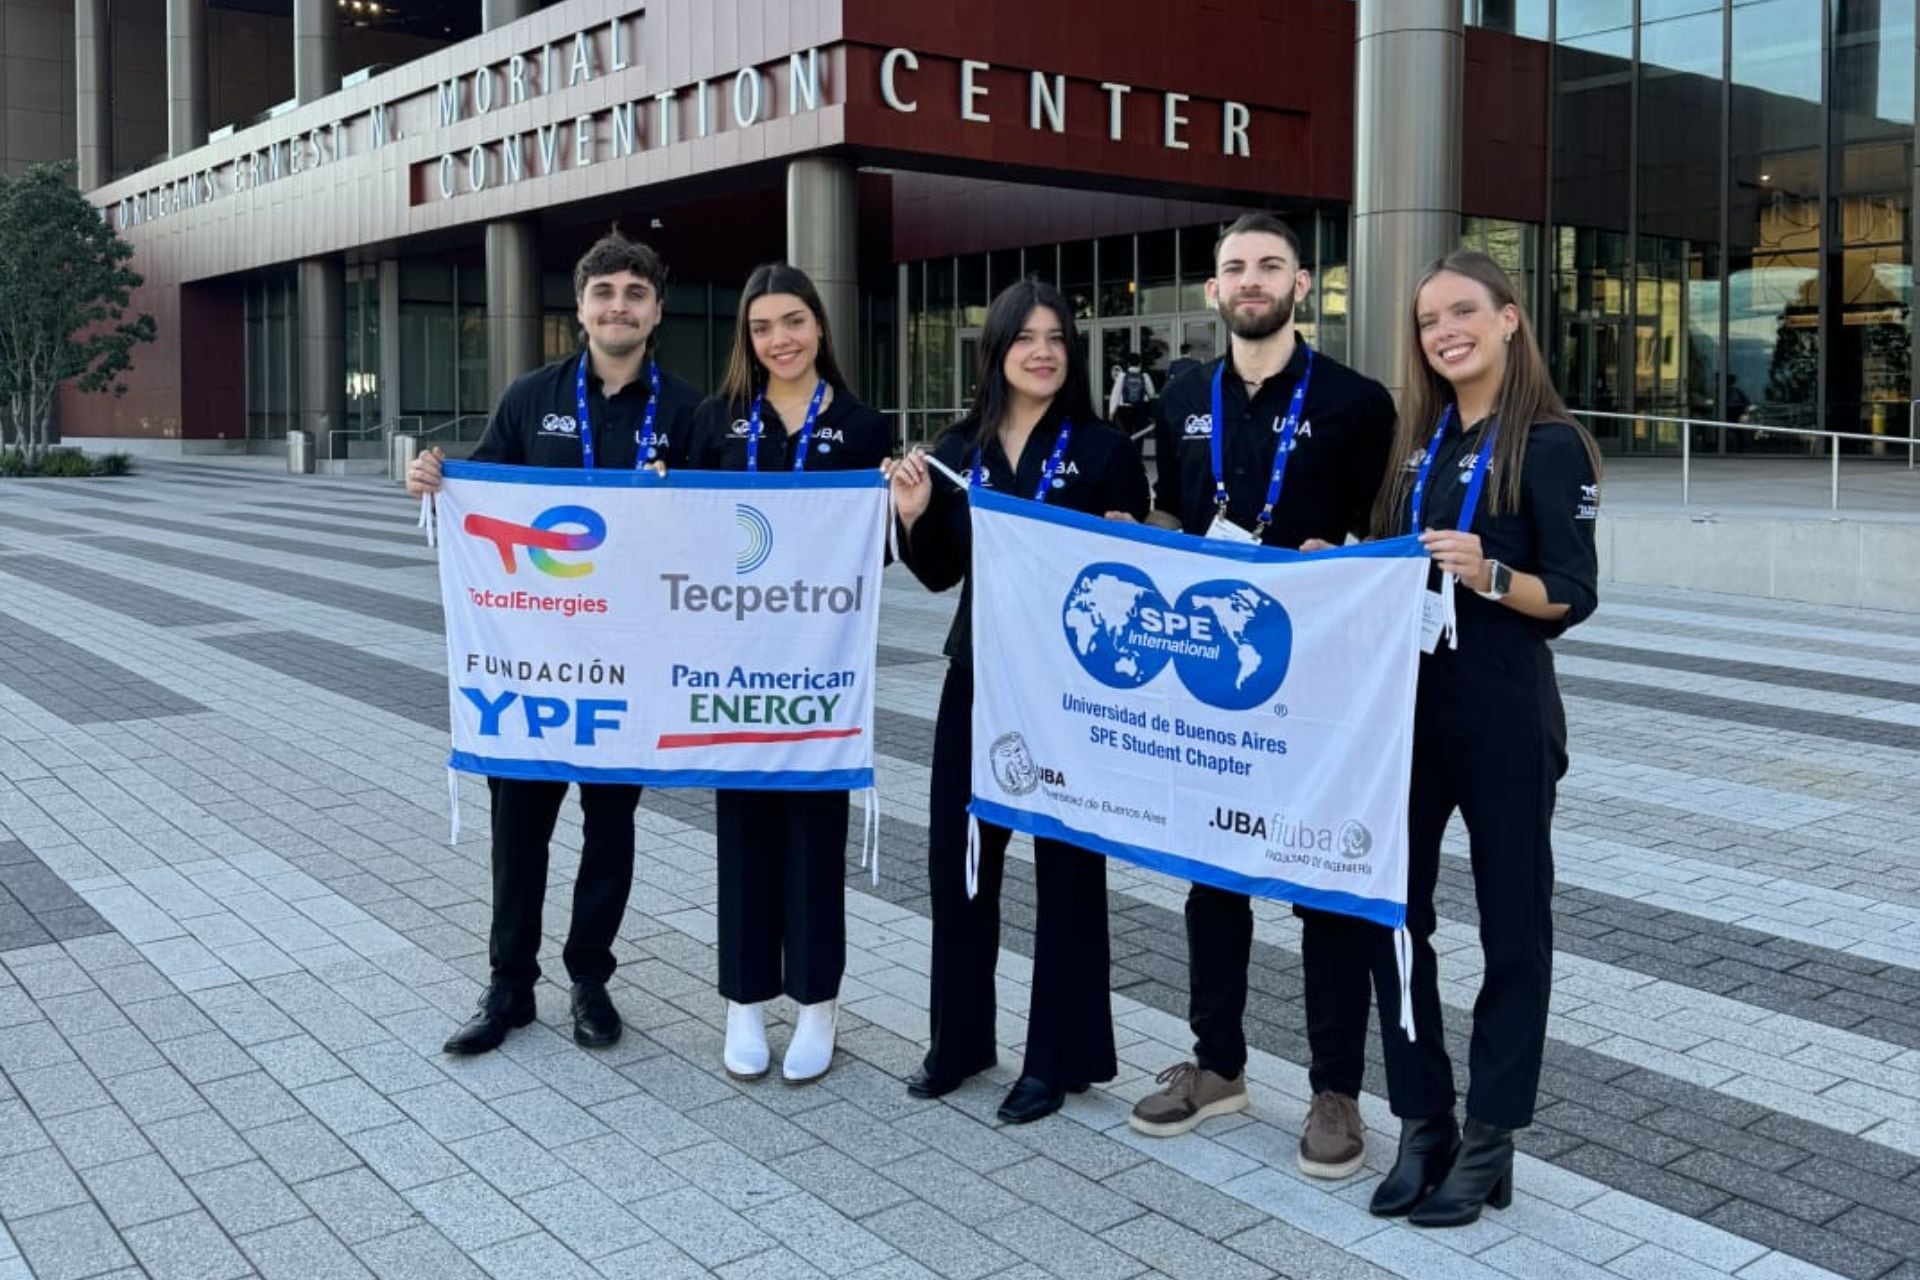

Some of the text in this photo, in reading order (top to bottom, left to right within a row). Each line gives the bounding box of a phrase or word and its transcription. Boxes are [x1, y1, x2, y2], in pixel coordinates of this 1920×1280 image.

[119, 17, 628, 230] ORLEANS ERNEST N. MORIAL
[439, 47, 1251, 199] CONVENTION CENTER
[468, 587, 608, 617] TotalEnergies
[660, 573, 864, 621] Tecpetrol
[1140, 607, 1213, 641] SPE
[1128, 628, 1221, 661] International
[467, 654, 625, 685] FUNDACIÓN
[671, 664, 855, 690] Pan American
[459, 686, 628, 747] YPF
[689, 693, 841, 726] ENERGY
[1062, 692, 1288, 755] Universidad de Buenos Aires
[1090, 725, 1252, 777] SPE Student Chapter
[1270, 812, 1332, 852] fiuba
